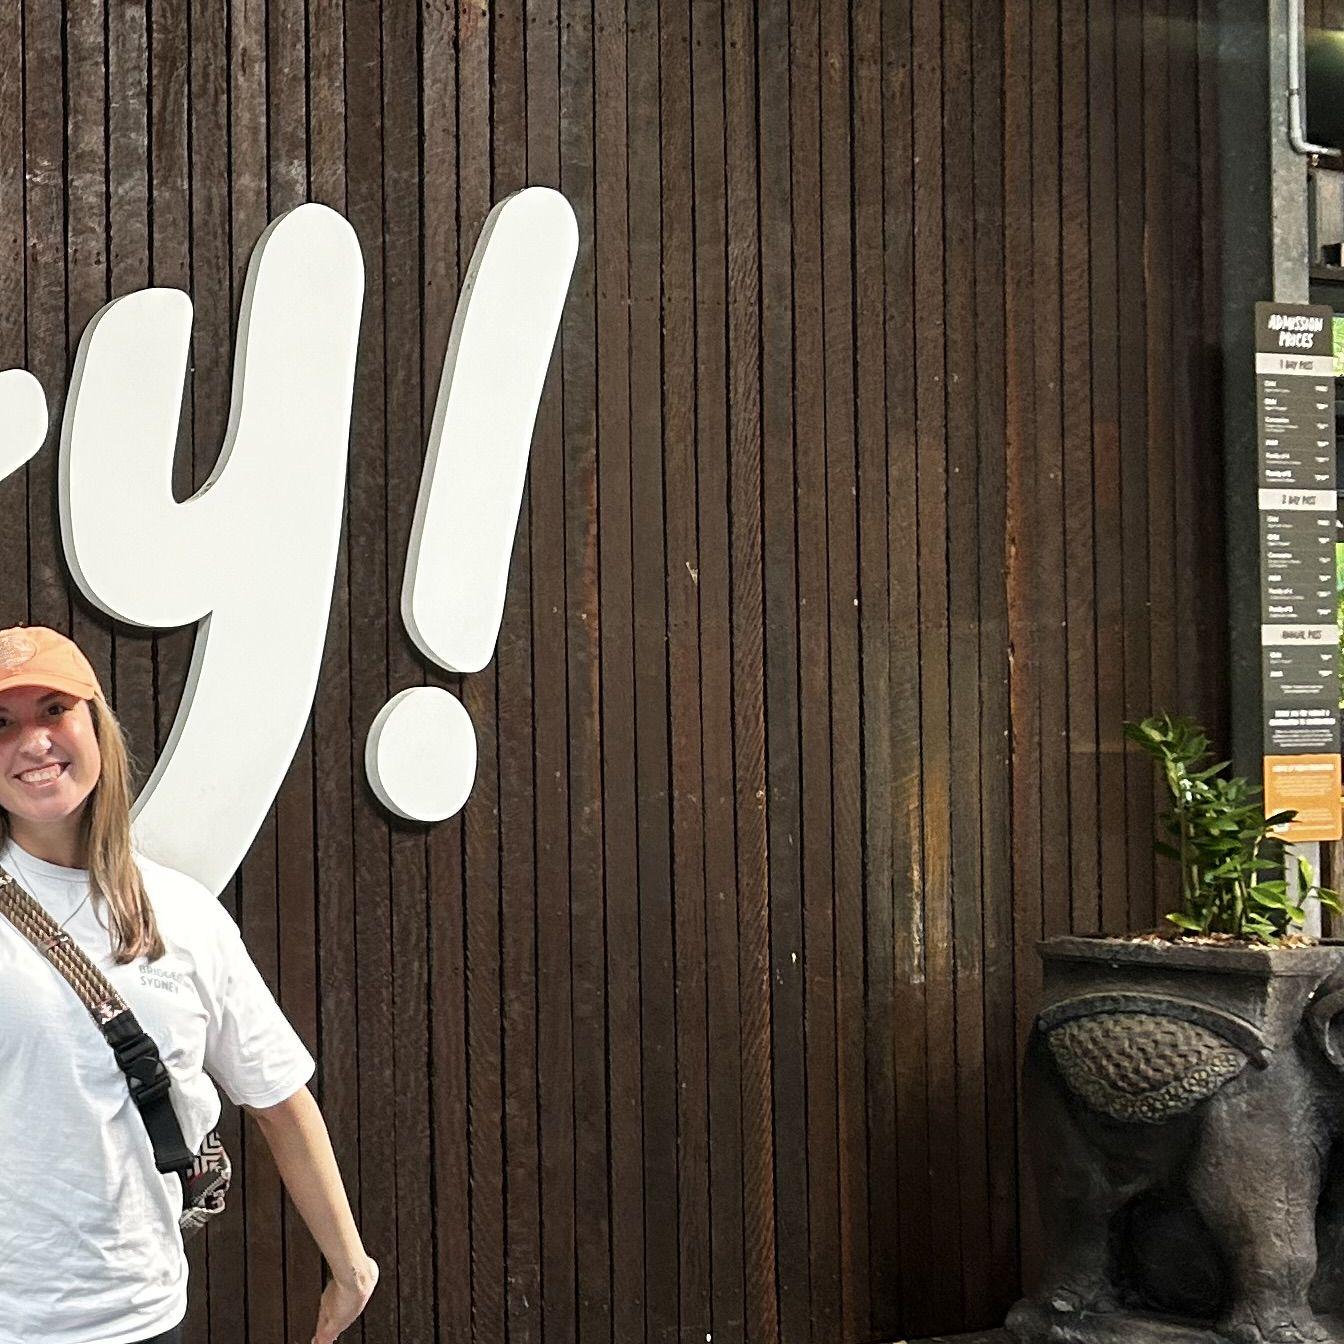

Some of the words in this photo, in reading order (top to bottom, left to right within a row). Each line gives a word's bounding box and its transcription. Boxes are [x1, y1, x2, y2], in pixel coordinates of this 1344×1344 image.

[1268, 314, 1324, 332] ADMISSION
[1278, 330, 1314, 349] PRICES
[140, 975, 179, 995] SYDNEY
